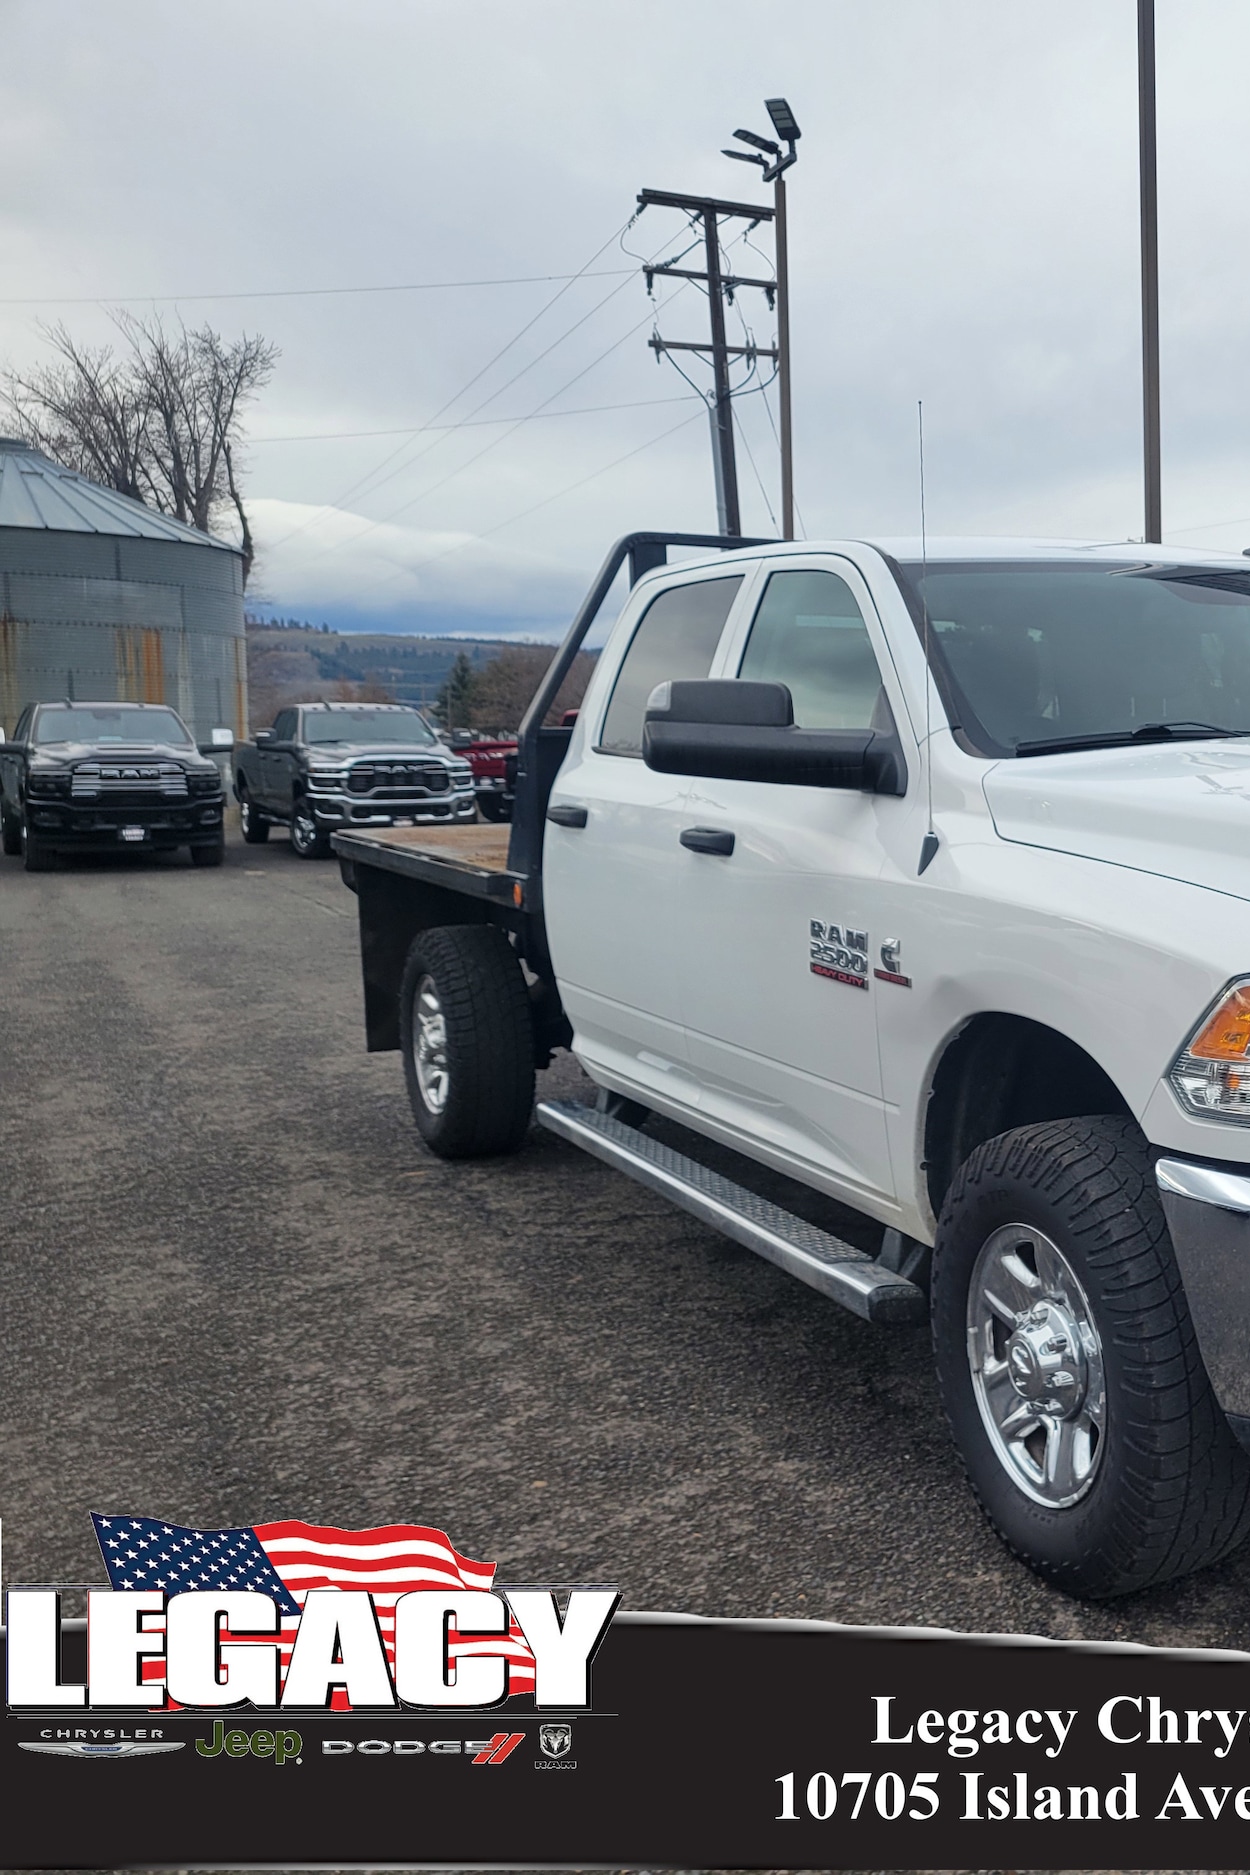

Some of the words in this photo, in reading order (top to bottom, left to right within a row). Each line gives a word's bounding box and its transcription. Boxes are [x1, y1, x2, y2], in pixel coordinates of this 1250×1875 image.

[101, 768, 160, 779] RAM
[809, 917, 869, 953] RAM
[809, 939, 869, 975] 2500
[837, 972, 864, 986] DUTY
